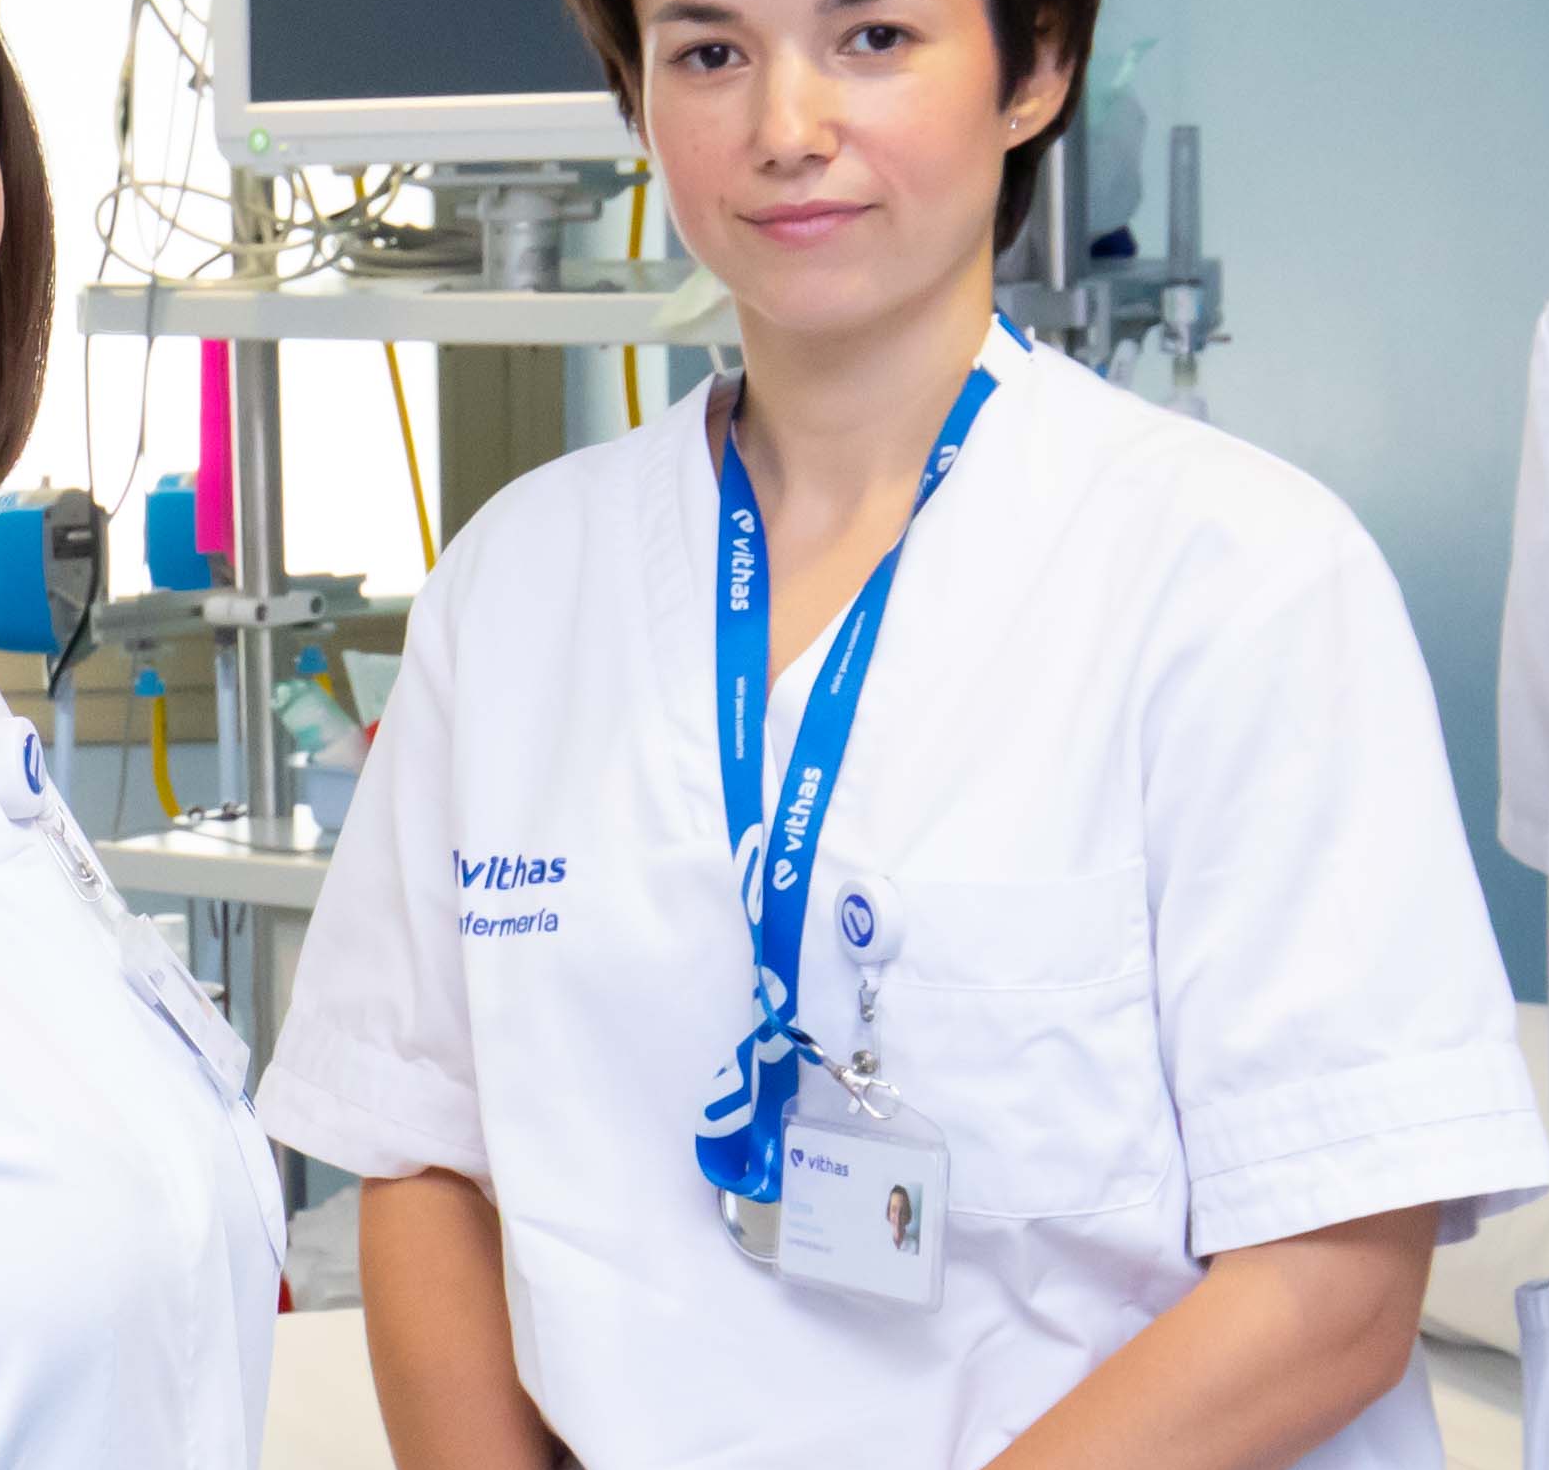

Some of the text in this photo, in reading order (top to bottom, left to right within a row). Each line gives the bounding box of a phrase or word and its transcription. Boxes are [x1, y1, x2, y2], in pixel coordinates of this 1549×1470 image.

[730, 537, 755, 612] vithas
[784, 766, 823, 852] vithas
[461, 854, 567, 890] vithas
[459, 908, 559, 937] fermería
[808, 1154, 850, 1177] vithas
